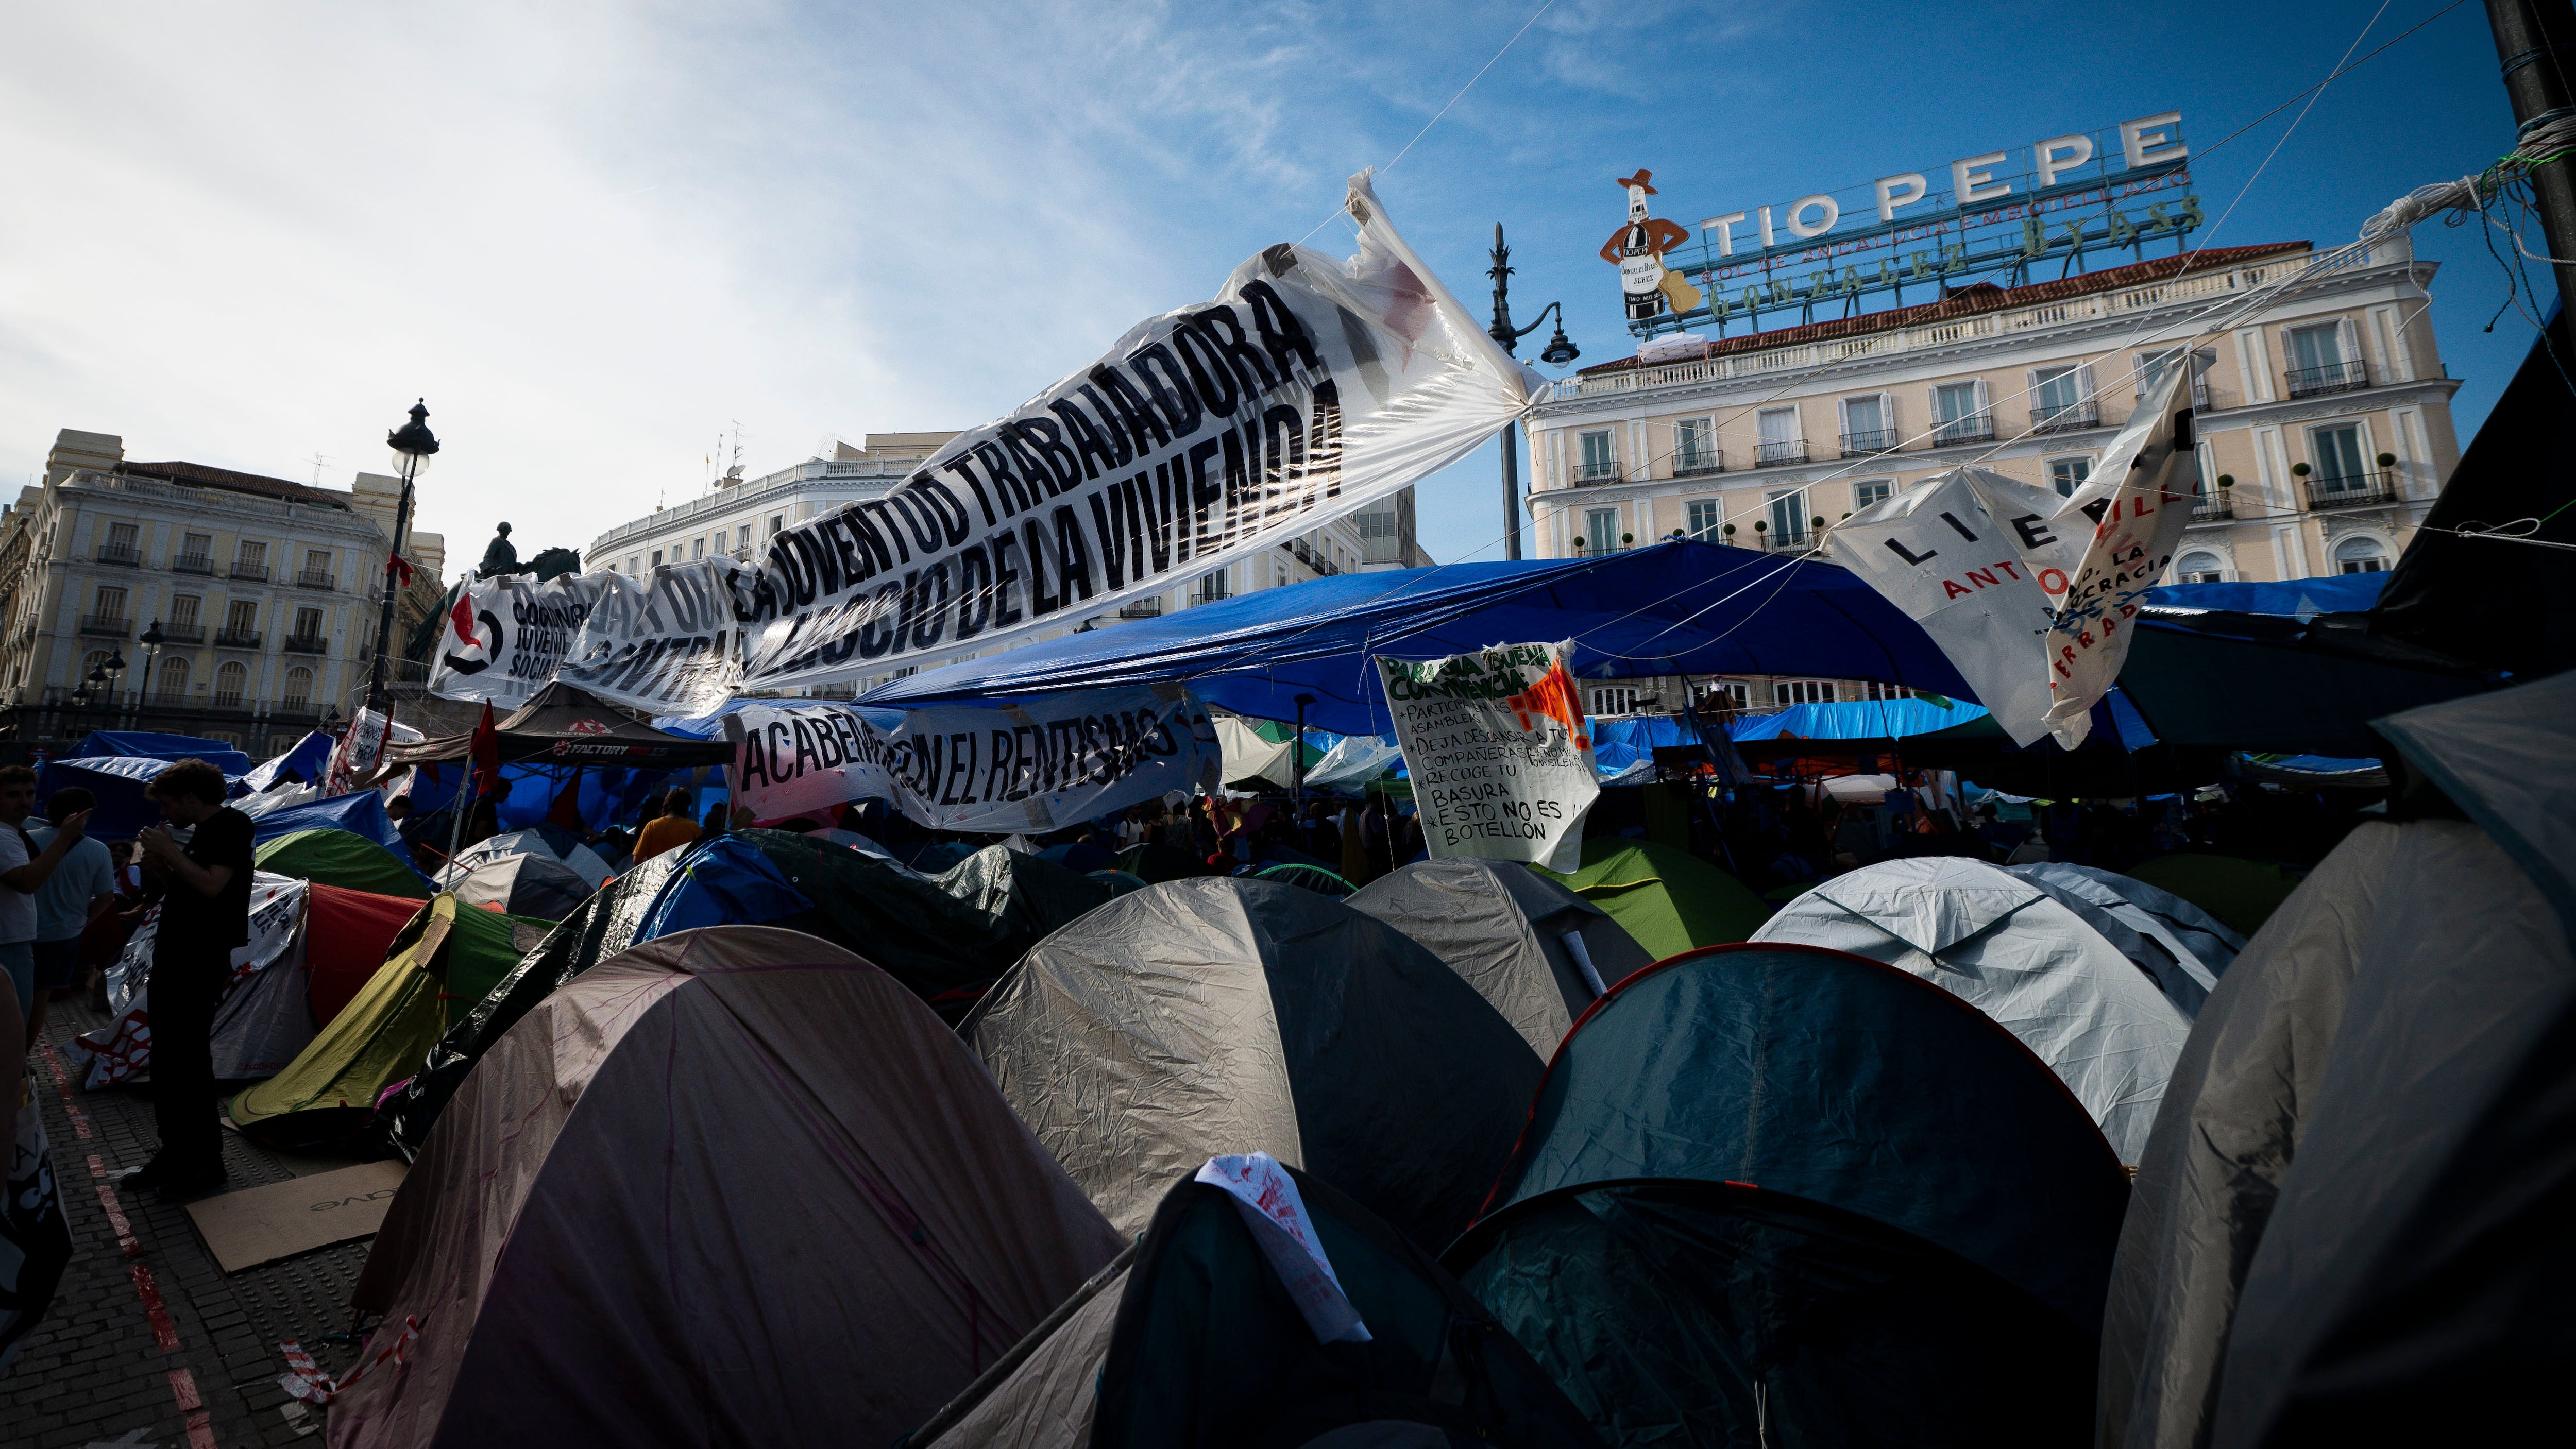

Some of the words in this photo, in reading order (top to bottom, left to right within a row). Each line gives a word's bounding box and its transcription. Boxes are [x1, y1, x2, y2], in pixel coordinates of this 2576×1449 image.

[1701, 192, 1838, 258] TIO
[1875, 109, 2189, 223] PEPE
[1702, 264, 1750, 284] SOL
[1758, 253, 1789, 272] DE
[1801, 220, 1950, 264] ANDALUCIA
[1962, 171, 2191, 230] EMBOTELLADO
[1709, 242, 1967, 317] GONZALEZ
[2022, 195, 2206, 257] BYASS
[1633, 274, 1654, 284] JEREZ
[768, 477, 969, 617] JUVENTUD
[947, 279, 1320, 526] TRABAJADORA
[956, 530, 1024, 641] DE
[1023, 504, 1093, 617] LA
[1093, 377, 1343, 592] VIVIENDA
[514, 627, 567, 655] JUVENIL
[1384, 657, 1436, 684] PARA
[1486, 645, 1552, 671] BUENA
[1406, 698, 1469, 722] PARTICIPA
[1472, 702, 1488, 713] EN
[1491, 702, 1512, 714] AS
[1411, 713, 1481, 735] ASAMBLEAS
[1415, 734, 1462, 756] DEJA
[1464, 728, 1534, 744] DESCANSAR
[1535, 730, 1547, 743] A
[1544, 747, 1558, 758] NO
[939, 731, 977, 806] EL
[1422, 747, 1527, 771] COMPAÑERAS
[1425, 765, 1492, 787] RECOGE
[1496, 764, 1517, 777] TU
[1431, 782, 1510, 809] BASURA
[1438, 803, 1496, 826] ESTO
[1502, 800, 1532, 821] NO
[1537, 800, 1563, 819] ES
